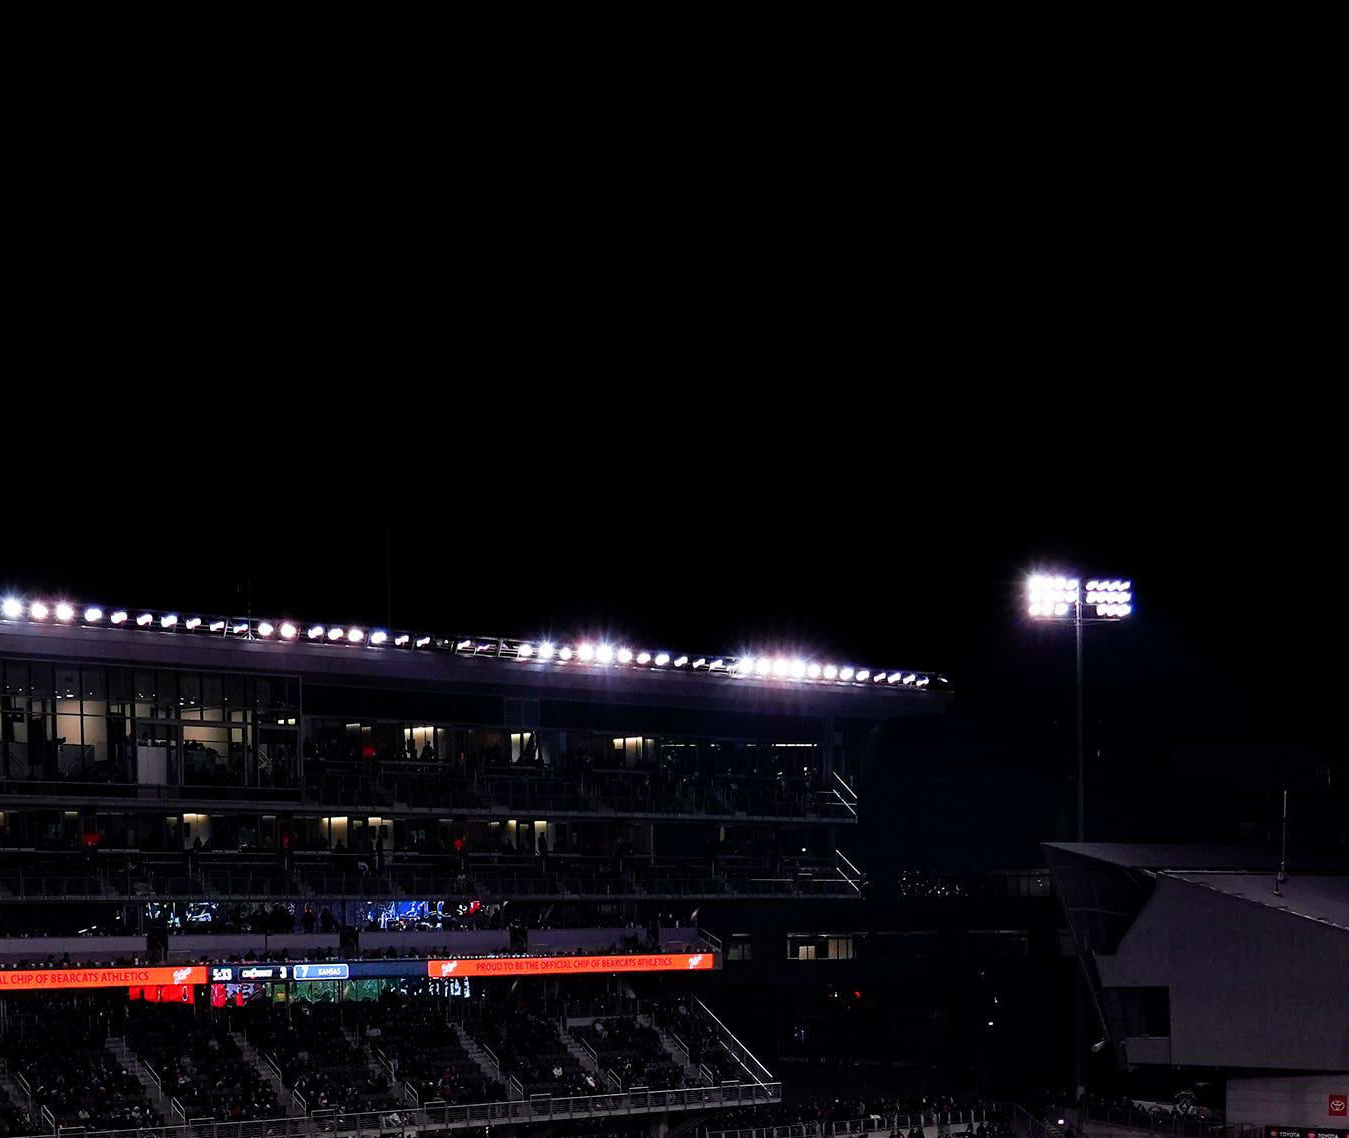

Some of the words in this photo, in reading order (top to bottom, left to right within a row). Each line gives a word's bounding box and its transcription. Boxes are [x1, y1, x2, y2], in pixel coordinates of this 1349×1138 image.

[477, 962, 502, 972] PROUD
[504, 962, 514, 971] TO
[515, 961, 524, 970] BE
[525, 961, 539, 970] THE
[541, 960, 571, 969] OFFICIAL
[573, 960, 590, 968] CHIP
[591, 959, 601, 968] OF
[602, 959, 636, 968] BEARCATS
[638, 958, 673, 967] ATHLETICS
[11, 973, 33, 985] CHIP
[36, 973, 48, 984] OF
[51, 972, 99, 983] BEARCATS
[101, 971, 150, 982] ATHLETICS
[213, 968, 232, 981] 5:33
[280, 967, 287, 979] 3
[302, 966, 309, 978] 7
[318, 968, 341, 976] KANSAS
